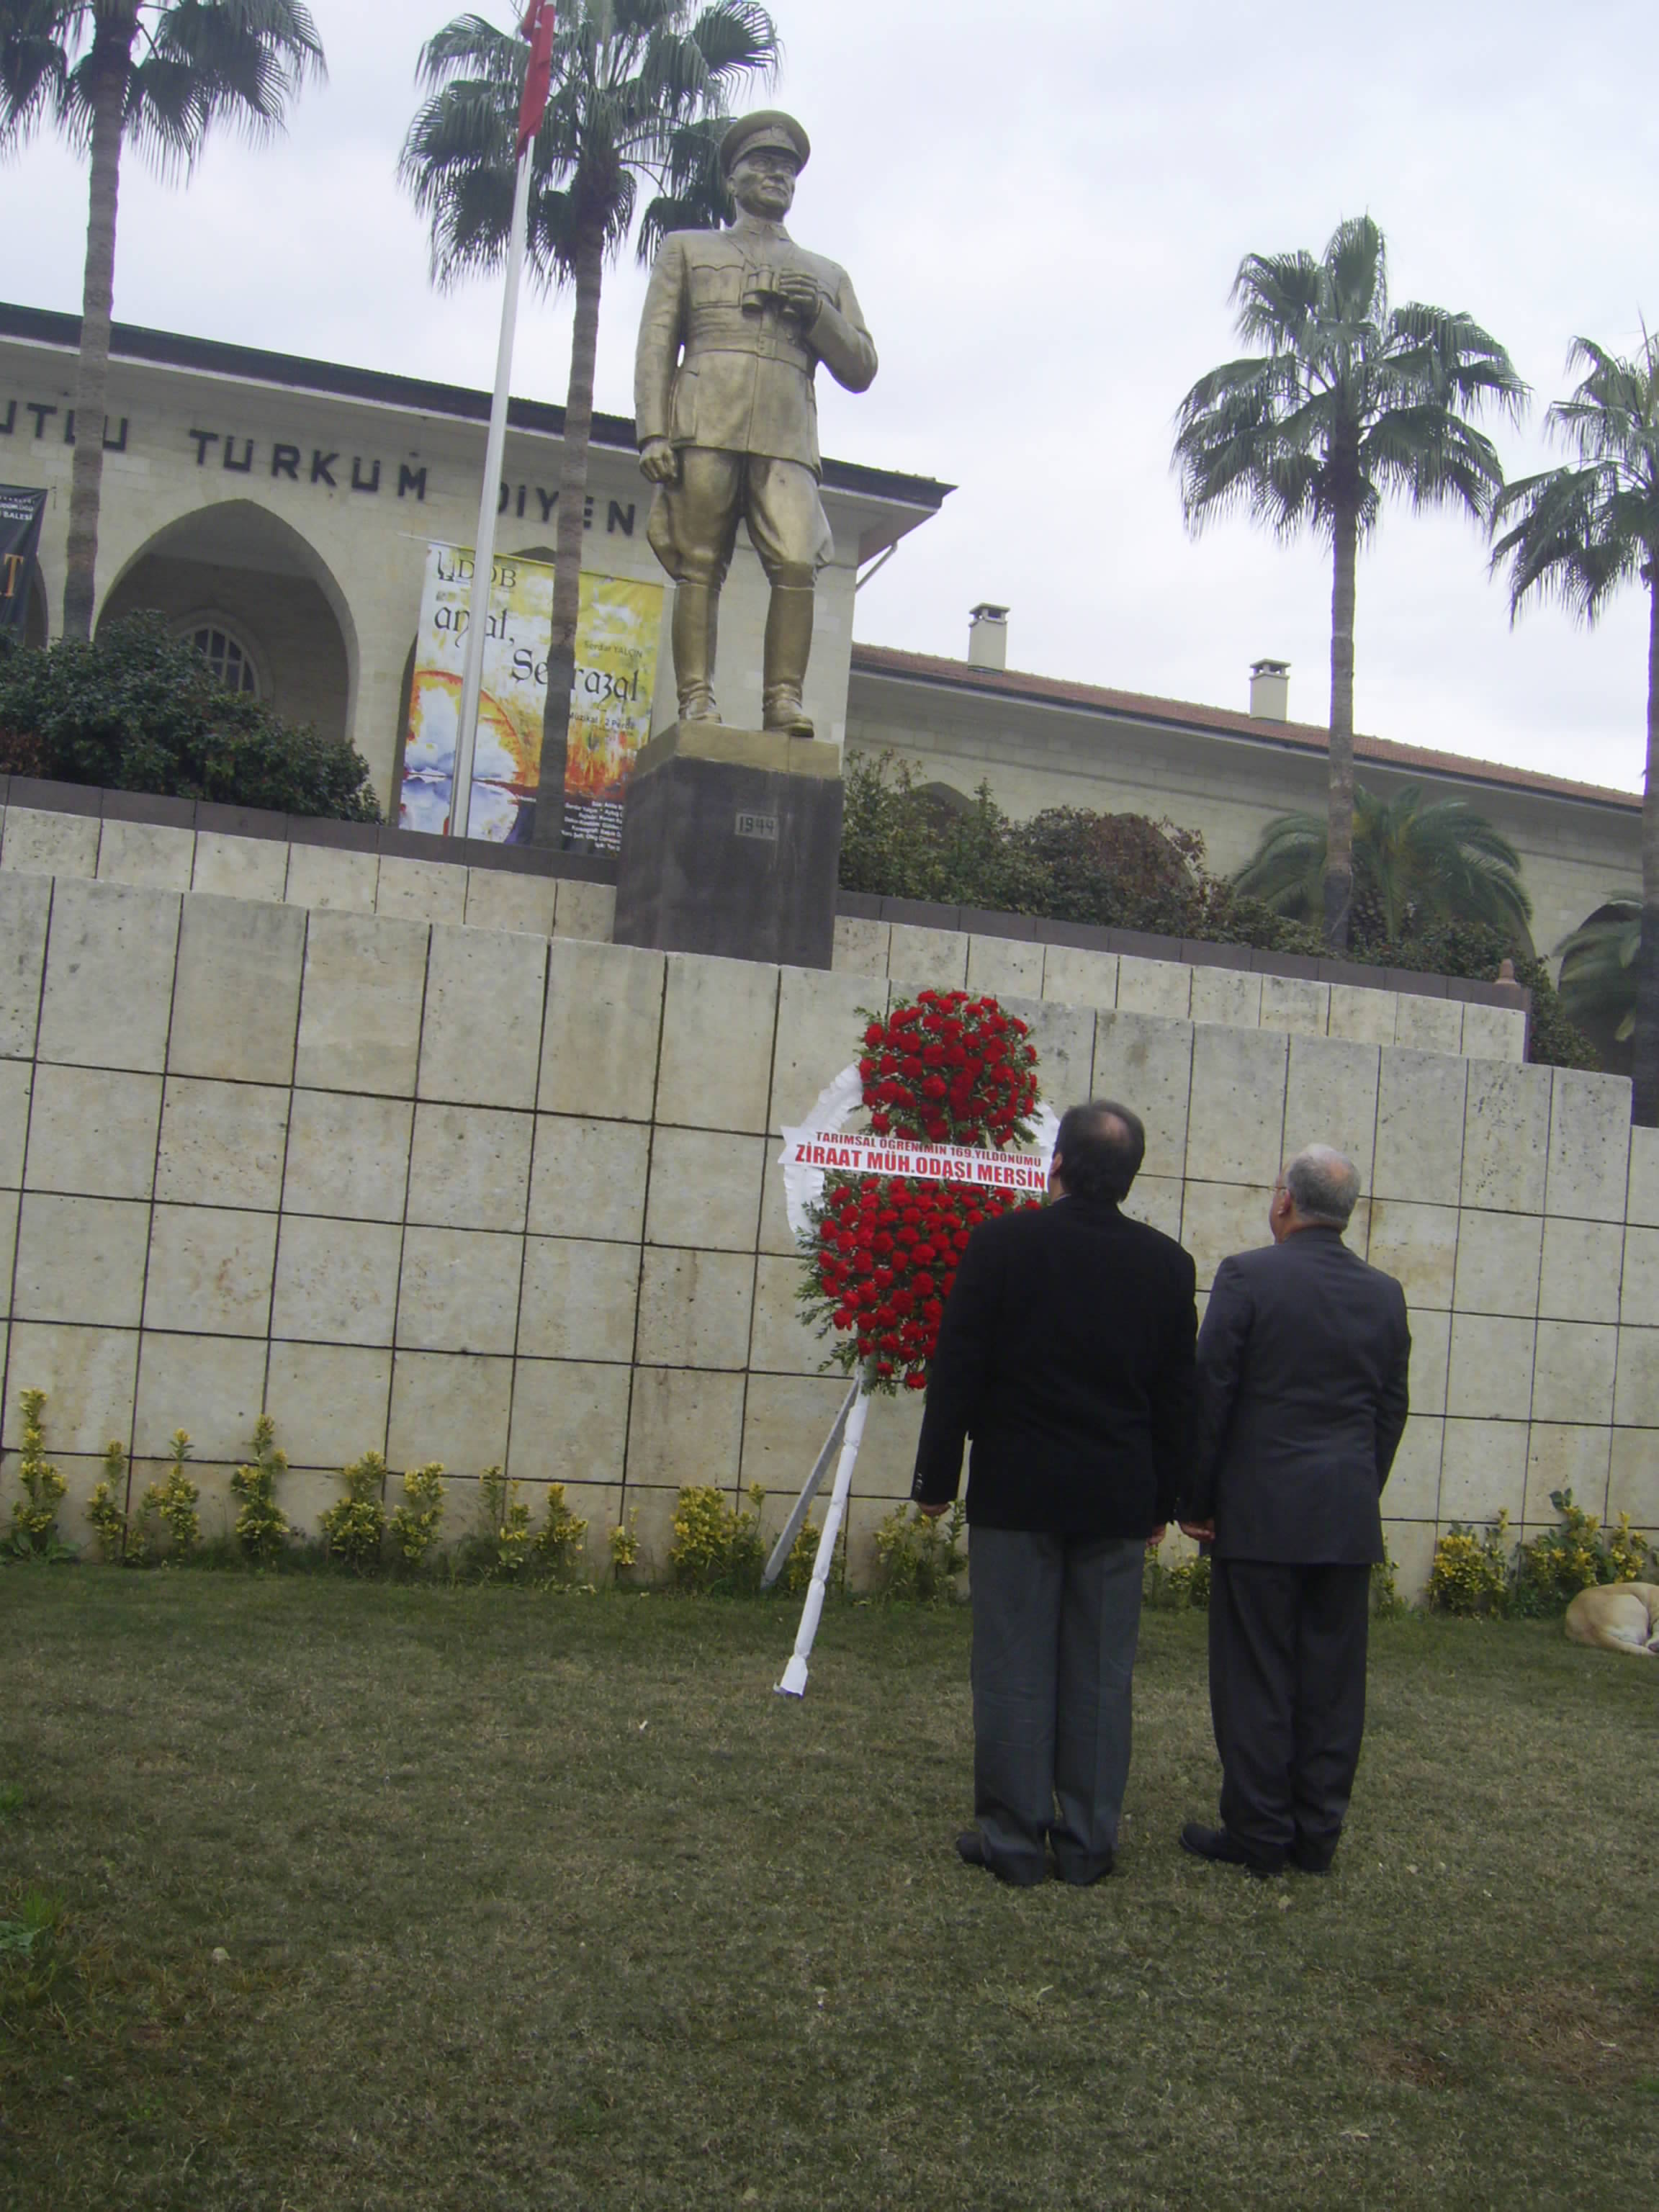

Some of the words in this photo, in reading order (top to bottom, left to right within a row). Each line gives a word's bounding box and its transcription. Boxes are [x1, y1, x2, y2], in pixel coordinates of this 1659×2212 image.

[189, 428, 427, 500] TÜRKÜM
[816, 1131, 876, 1148] TARIMSAL
[794, 1141, 863, 1169] ZİRAAT
[977, 1163, 1046, 1189] MERSİN
